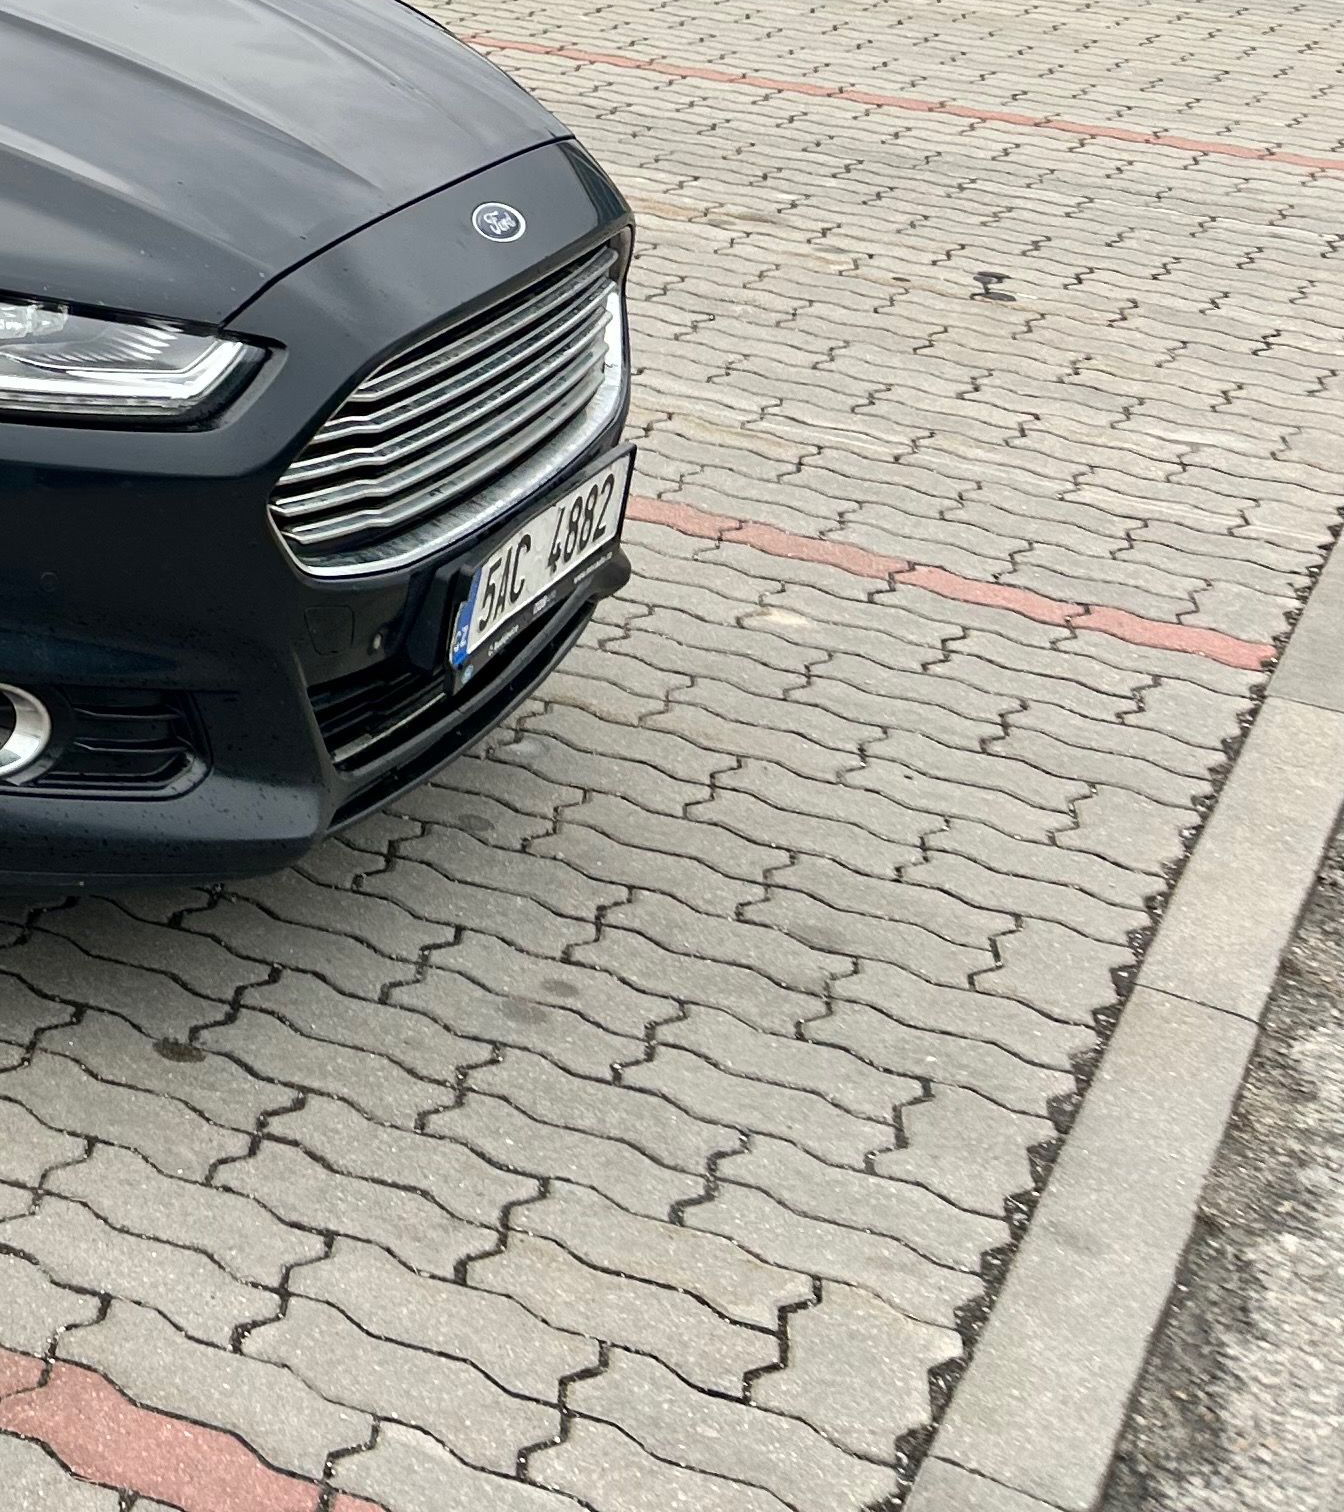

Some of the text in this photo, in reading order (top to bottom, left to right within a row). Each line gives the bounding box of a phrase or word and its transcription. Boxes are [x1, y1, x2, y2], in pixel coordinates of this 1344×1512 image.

[483, 210, 516, 235] Ford
[479, 473, 615, 632] 5AC 4882
